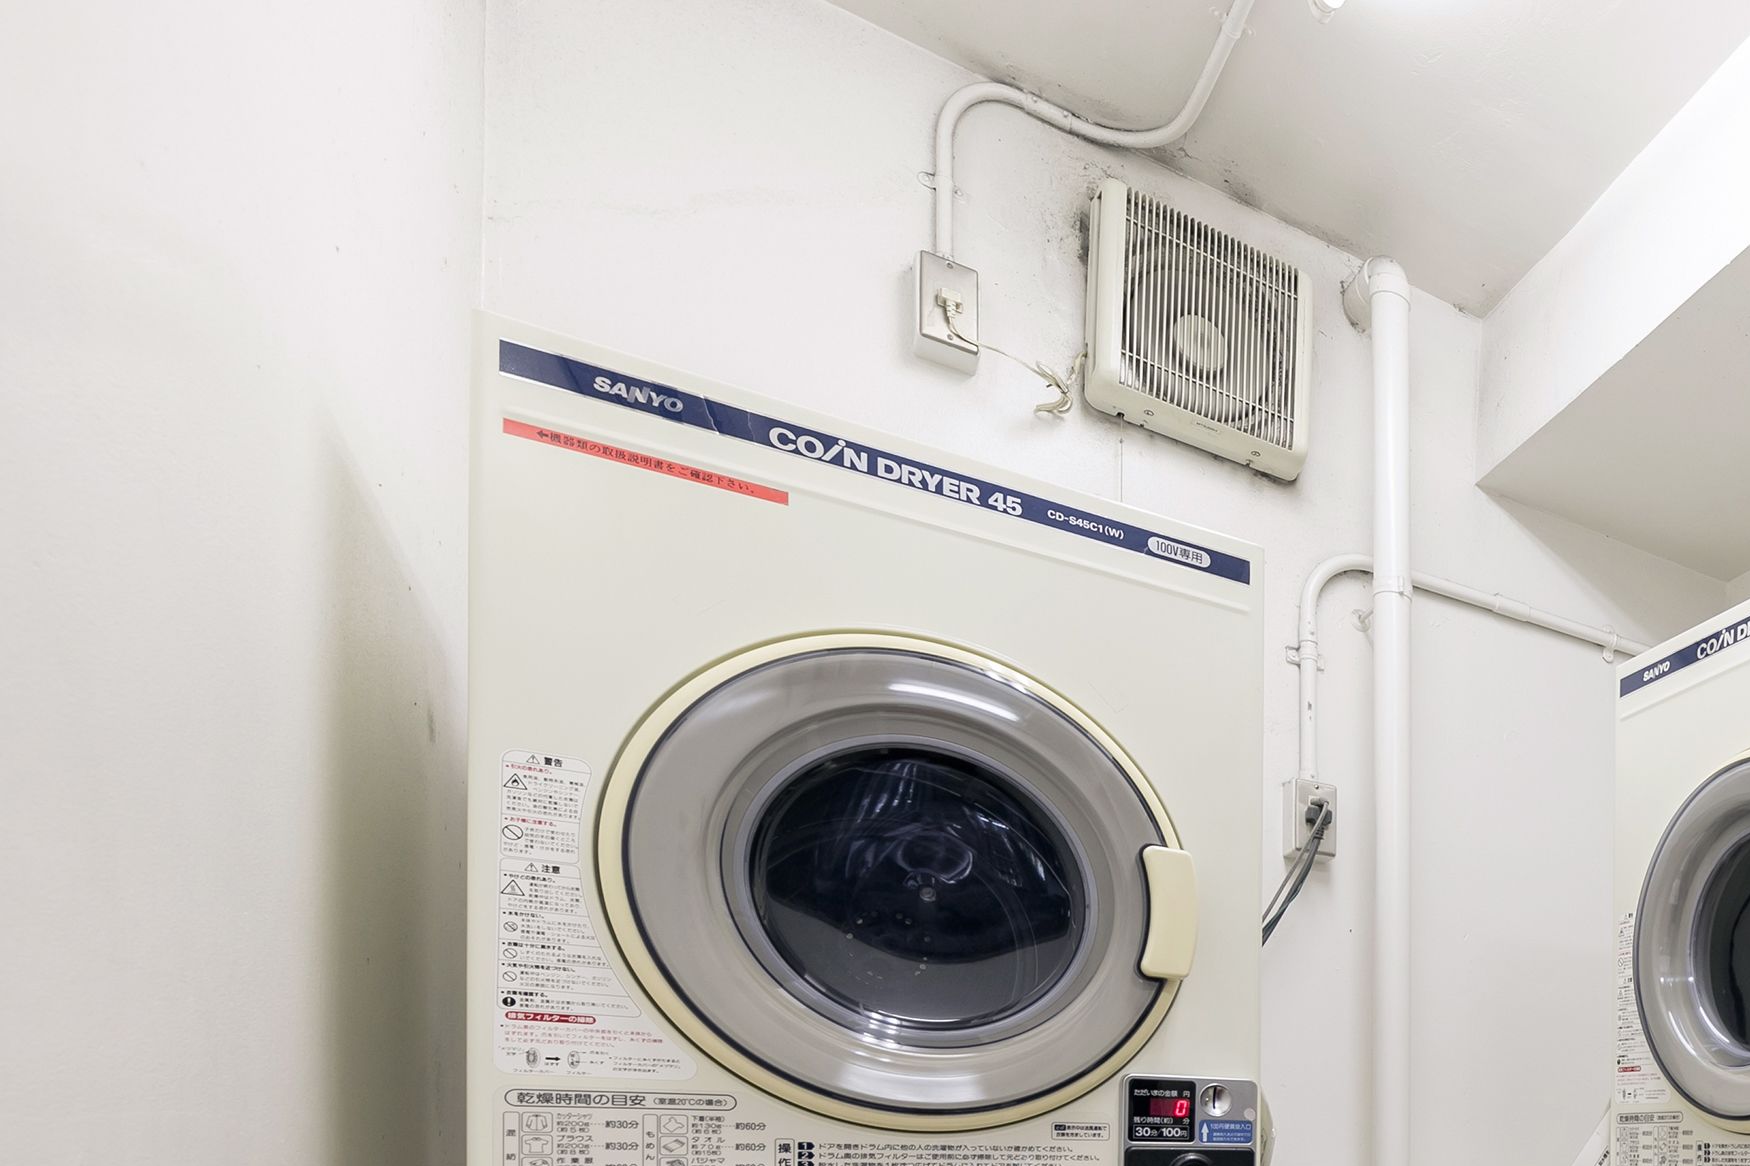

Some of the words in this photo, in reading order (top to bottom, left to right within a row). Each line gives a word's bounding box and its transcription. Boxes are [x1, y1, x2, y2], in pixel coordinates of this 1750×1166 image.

[592, 374, 684, 415] SANYO
[877, 456, 980, 505] DRYER
[988, 492, 1022, 516] 45
[1047, 509, 1124, 540] CD-S45C1(W)
[1155, 540, 1203, 564] 100V専用
[1642, 661, 1670, 682] SANYO
[544, 757, 563, 767] 警告
[541, 864, 561, 874] 注意
[1134, 1089, 1178, 1097] ただいまの金額
[517, 1092, 646, 1106] 乾燥時間の目安
[1175, 1100, 1187, 1116] 0
[605, 1120, 639, 1129] 約30分
[735, 1122, 766, 1130] 約60分
[1135, 1127, 1188, 1137] 30分/100円
[605, 1142, 639, 1150] 約30分
[735, 1143, 766, 1151] 約60分
